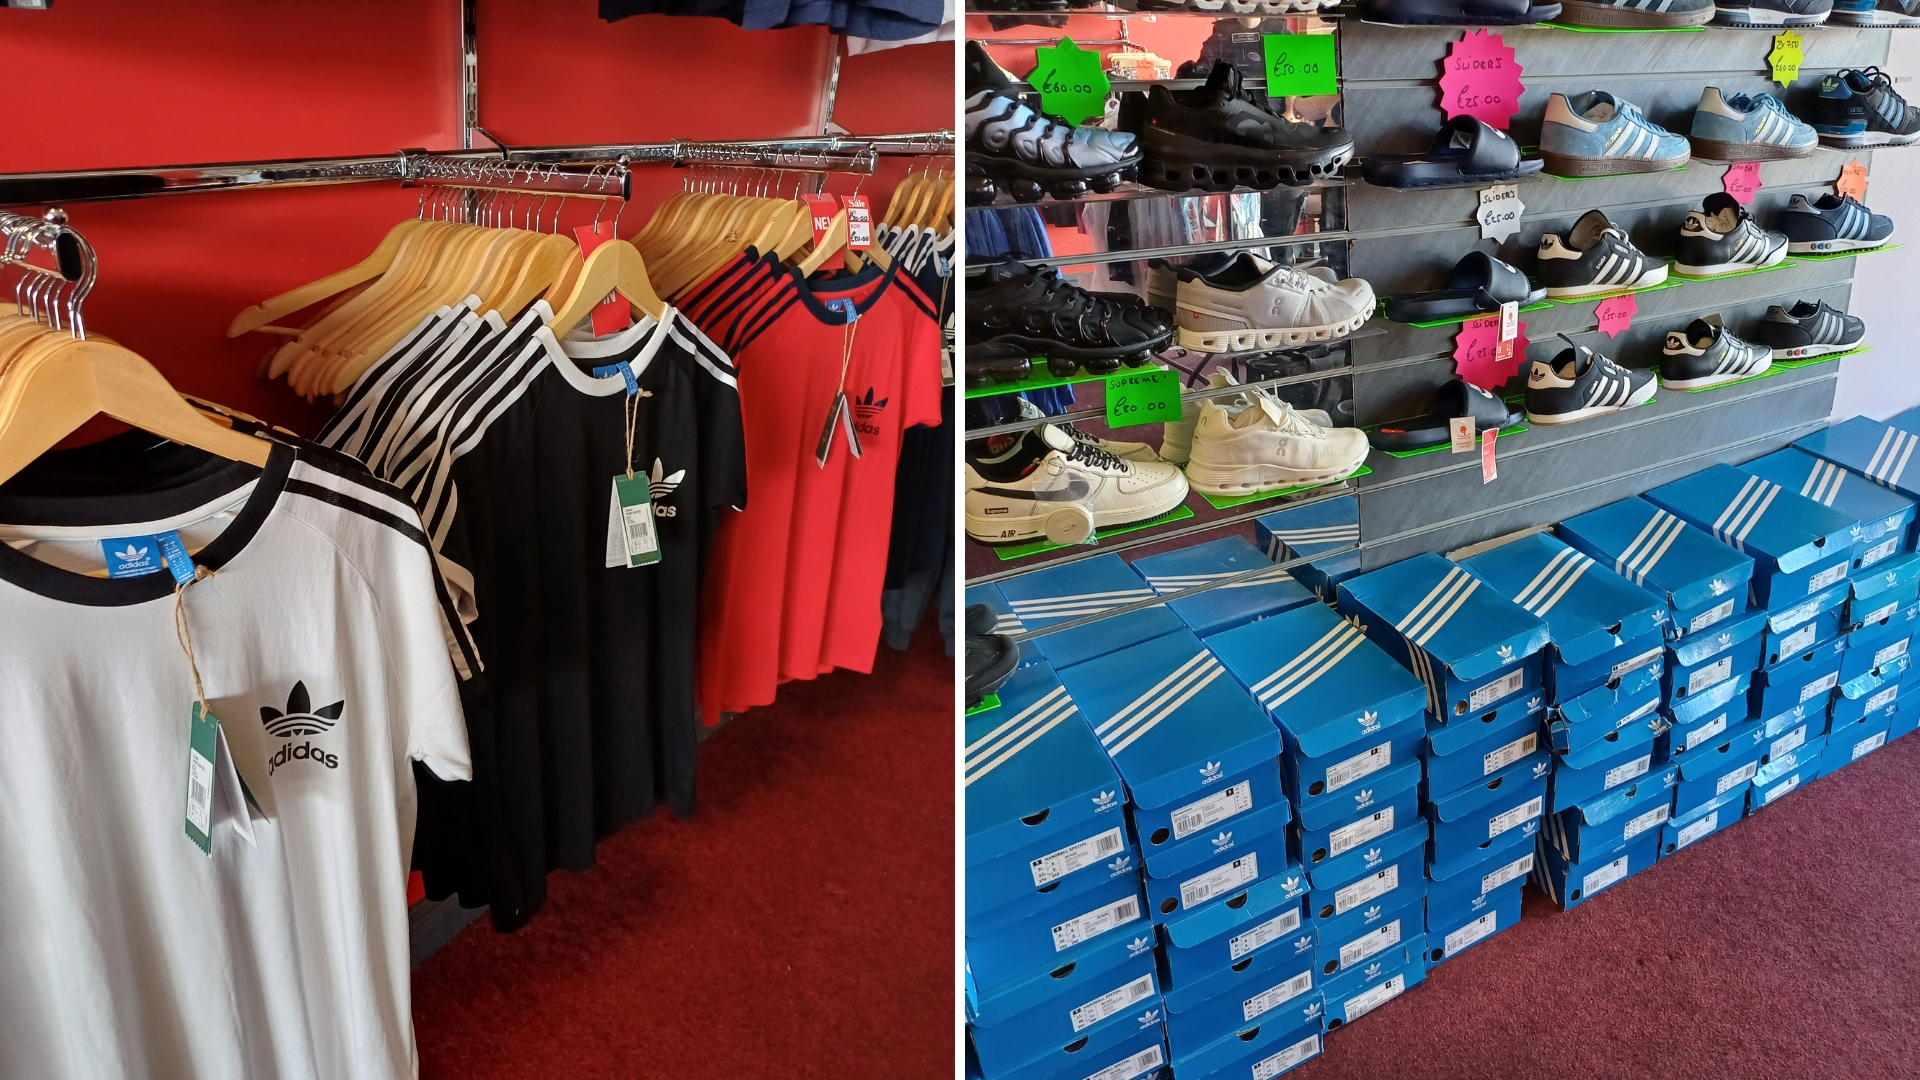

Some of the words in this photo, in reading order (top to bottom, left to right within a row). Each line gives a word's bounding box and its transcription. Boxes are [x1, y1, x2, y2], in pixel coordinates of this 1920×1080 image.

[848, 199, 866, 208] Sale
[1000, 530, 1016, 538] AIR
[118, 560, 150, 570] adidas
[1362, 722, 1381, 734] adidas
[268, 742, 338, 776] adidas
[1202, 771, 1224, 785] adidas
[1095, 801, 1118, 814] adidas
[1356, 798, 1374, 810] adidas
[1214, 841, 1234, 854] adidas
[1366, 858, 1382, 869] adidas
[1110, 866, 1132, 878] adidas
[1285, 886, 1303, 899] adidas
[1365, 913, 1381, 924] adidas
[1129, 946, 1150, 958] adidas
[1366, 970, 1381, 982] adidas
[1305, 1012, 1322, 1022] adidas
[1139, 1018, 1160, 1030] adidas
